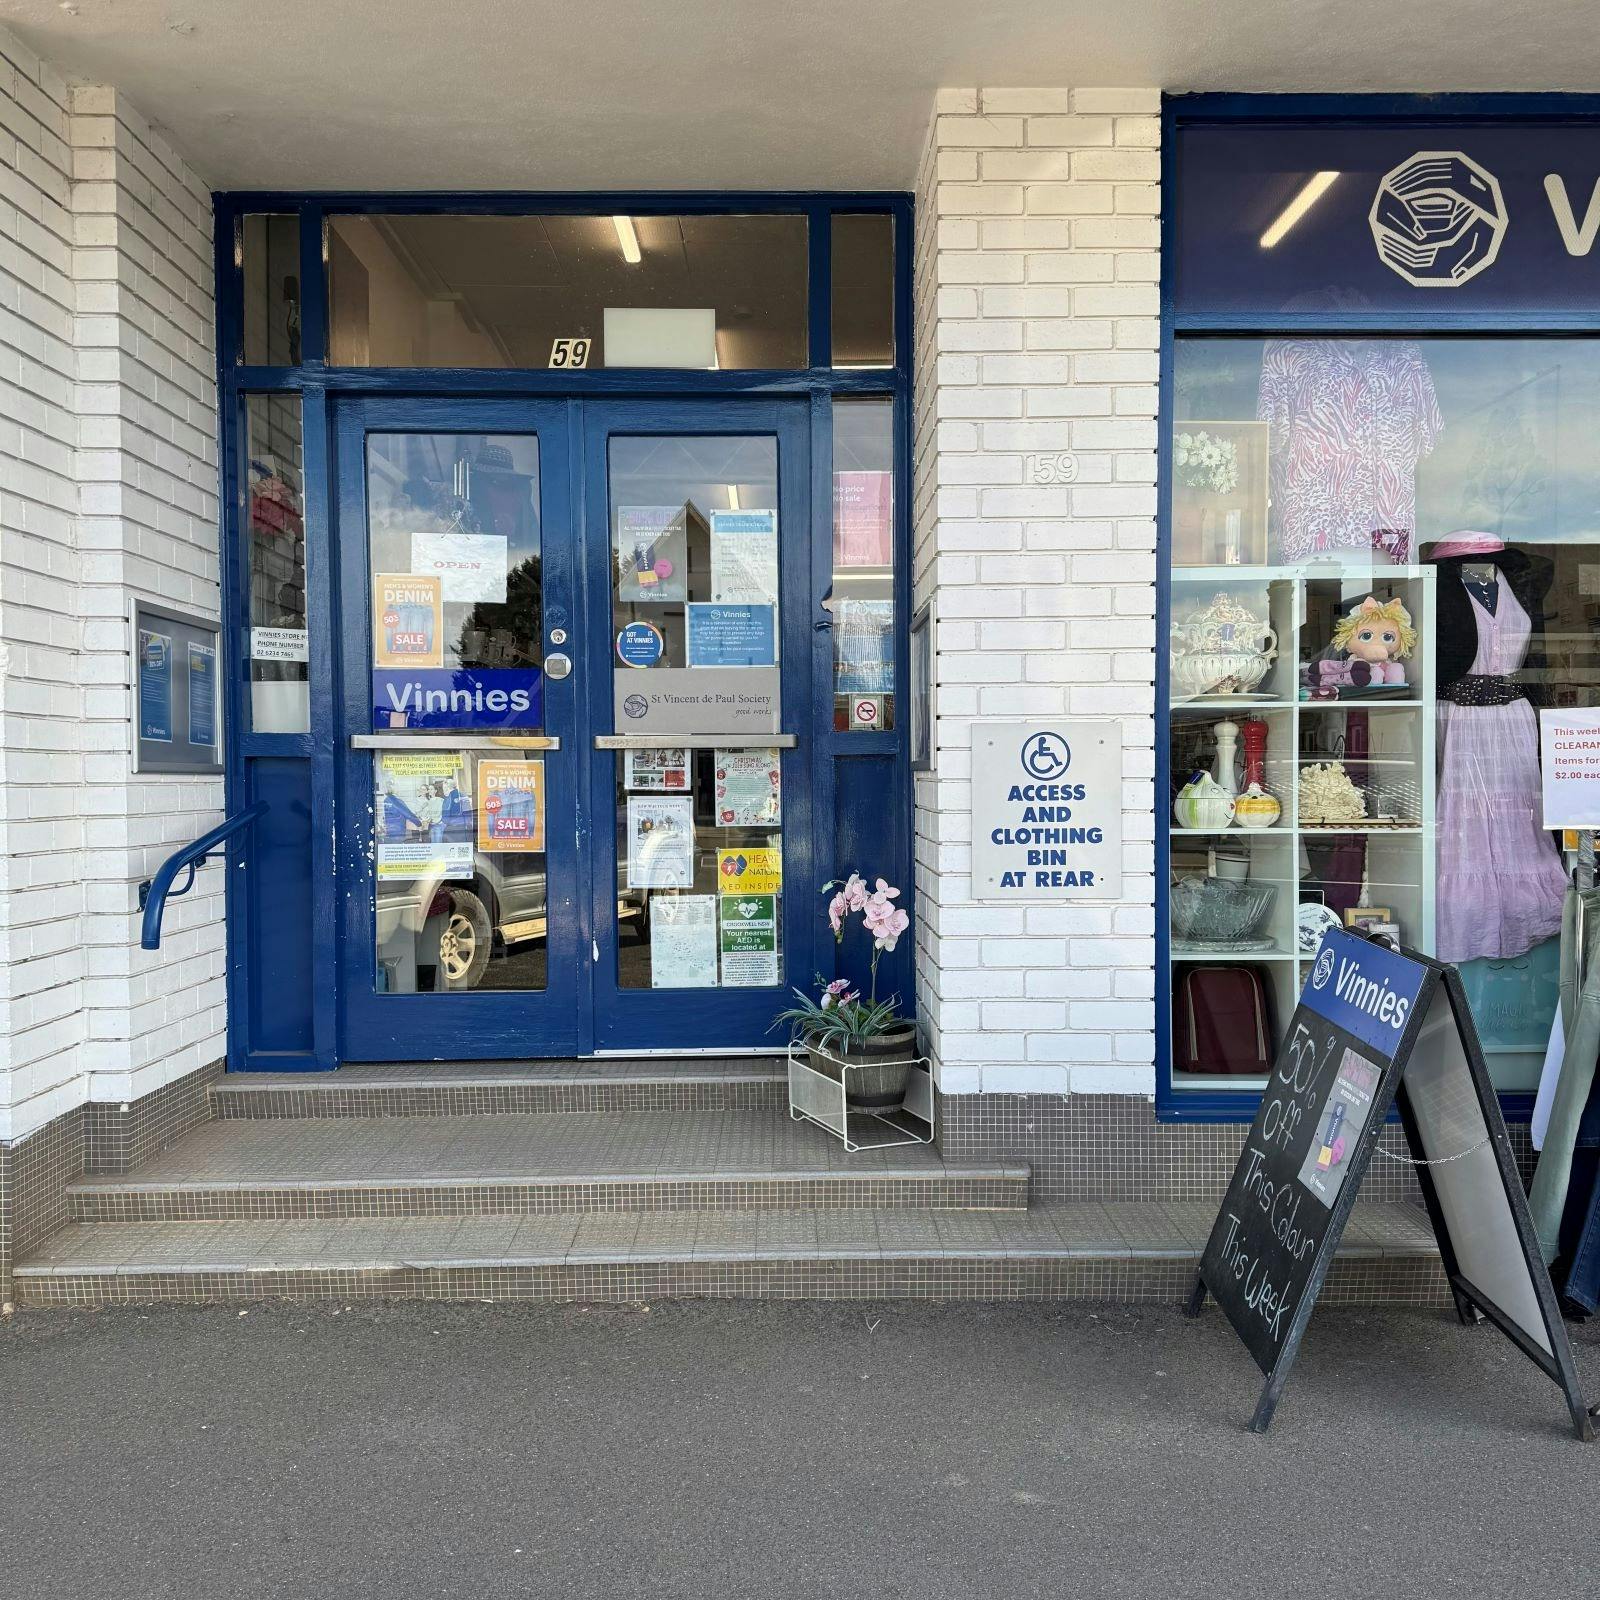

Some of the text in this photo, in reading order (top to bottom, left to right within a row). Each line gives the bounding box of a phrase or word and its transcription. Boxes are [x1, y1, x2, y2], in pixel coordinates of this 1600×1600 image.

[552, 340, 588, 367] 59
[433, 561, 481, 570] OPEN
[384, 590, 434, 603] DENIM
[396, 634, 424, 644] SALE
[386, 682, 530, 712] Vinnies
[651, 694, 771, 704] St Vincent de Paul Society
[1554, 728, 1574, 736] This
[1555, 756, 1600, 765] Items for
[487, 776, 536, 788] DENIM
[1555, 771, 1582, 780] $2.00
[1007, 784, 1086, 802] ACCESS
[1022, 806, 1072, 822] AND
[498, 820, 526, 829] SALE
[991, 828, 1103, 845] CLOTHING
[749, 854, 778, 864] HEART
[1028, 850, 1066, 866] BIN
[745, 882, 781, 890] INSIDE
[1000, 870, 1094, 888] AT REAR
[1335, 957, 1409, 1029] Vinnies
[1279, 1022, 1337, 1110] 50%
[1242, 1147, 1314, 1262] This Colour
[1220, 1213, 1291, 1343] This Week
